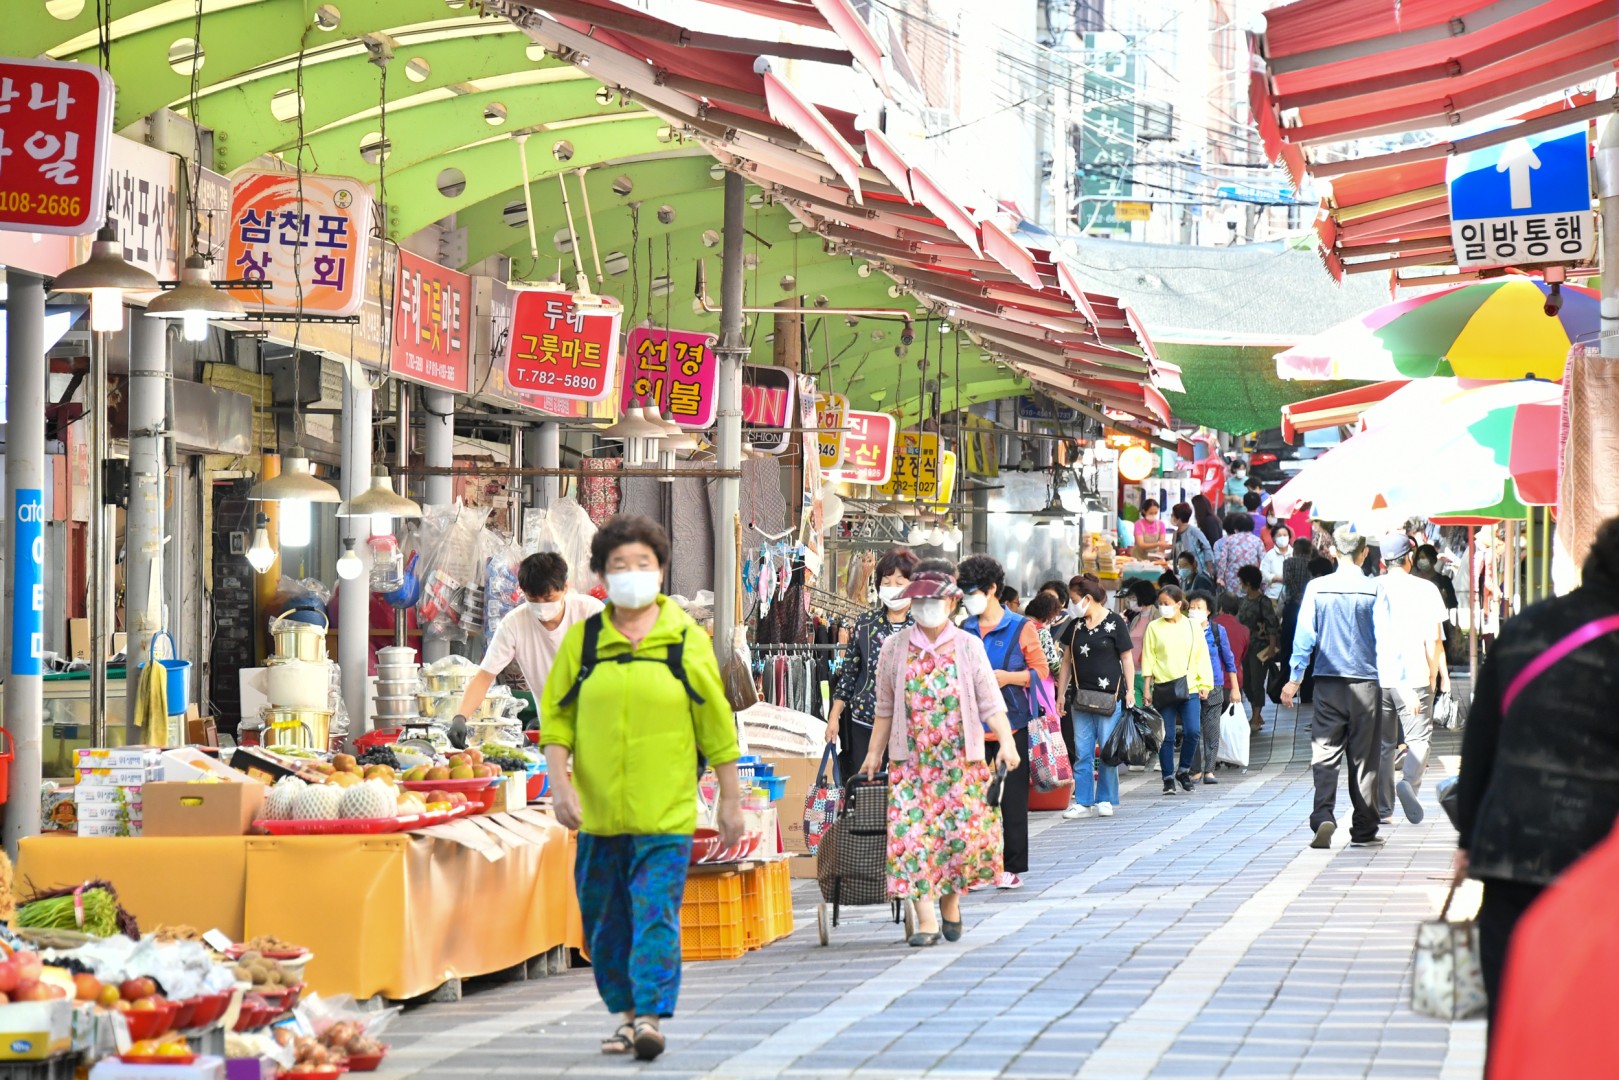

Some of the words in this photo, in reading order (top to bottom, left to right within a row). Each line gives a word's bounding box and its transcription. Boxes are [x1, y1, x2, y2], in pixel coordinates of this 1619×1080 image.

[0, 128, 79, 185] 일
[239, 209, 349, 249] 삼천포
[1461, 215, 1583, 261] 일방통행
[516, 333, 602, 369] 그릇마트
[637, 338, 705, 377] 선경
[516, 367, 598, 391] T.782-5890
[633, 376, 702, 416] 이불
